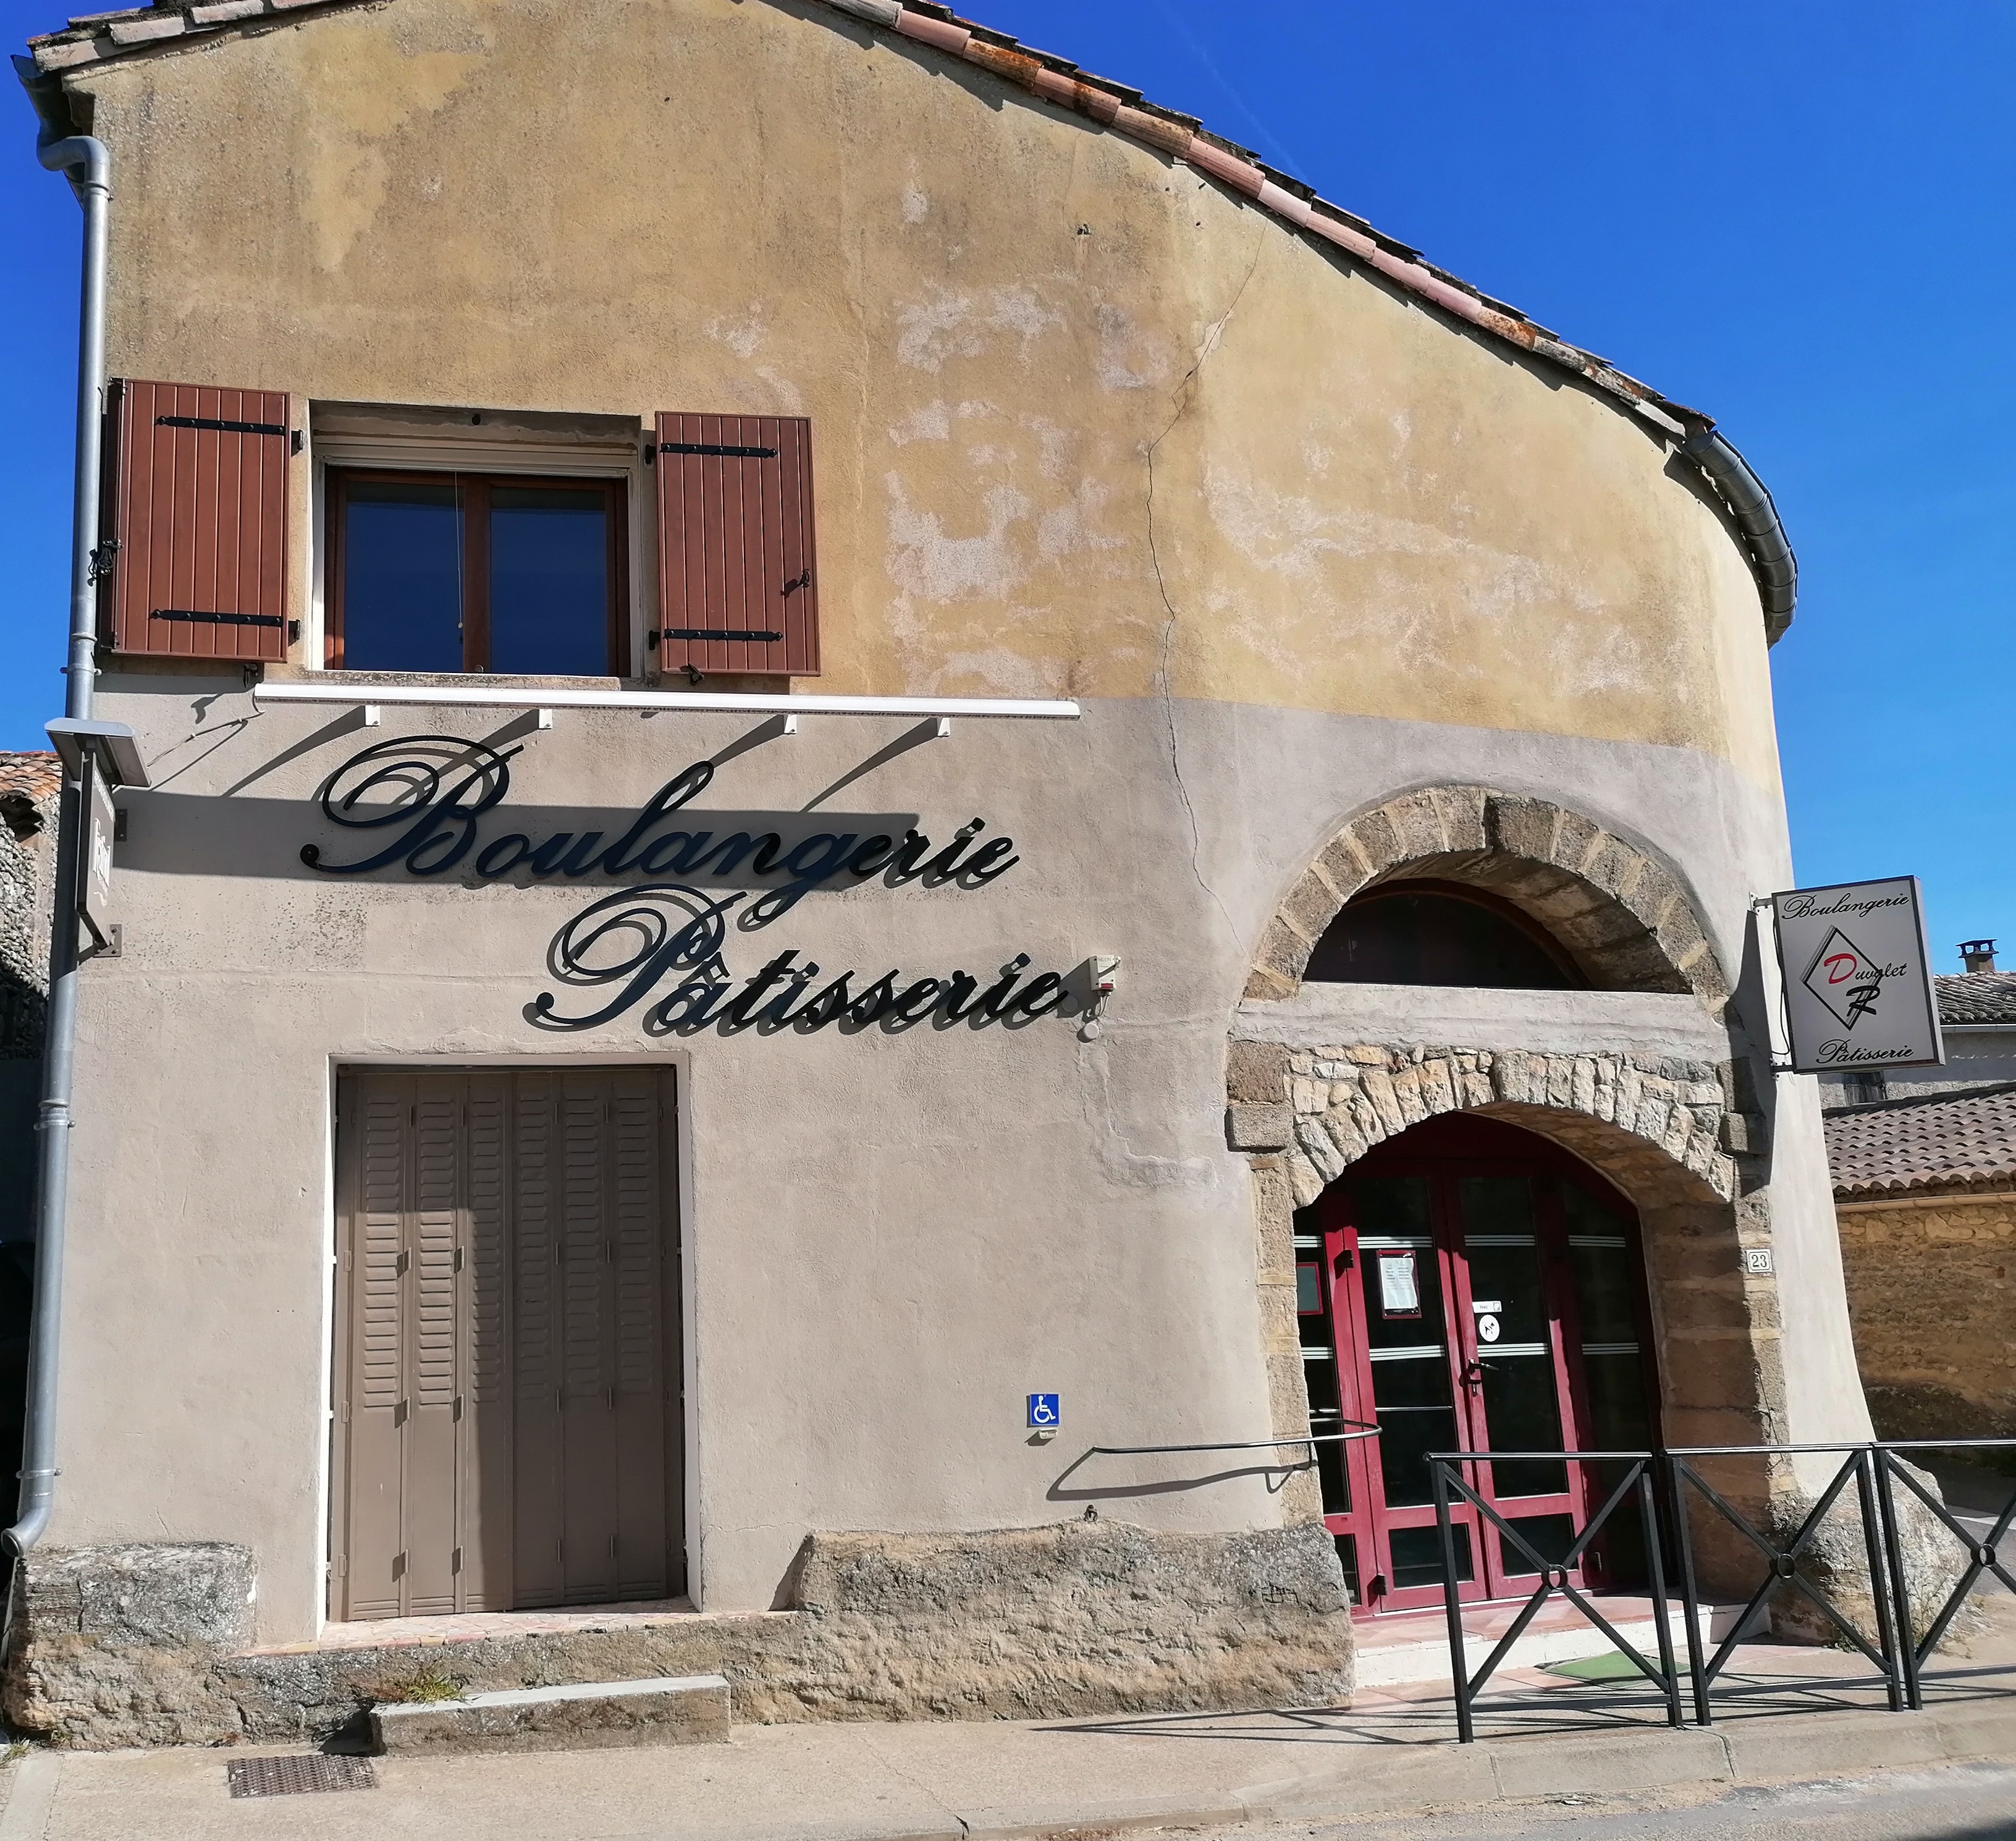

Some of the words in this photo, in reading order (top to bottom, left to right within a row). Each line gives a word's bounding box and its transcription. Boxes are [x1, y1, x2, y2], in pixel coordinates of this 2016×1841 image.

[300, 735, 1019, 922] Boulangerie
[1782, 893, 1909, 920] Boulangerie
[536, 884, 1069, 1028] Pâtisserie
[1816, 1039, 1913, 1064] Pâtisserie
[1752, 1255, 1767, 1268] 23
